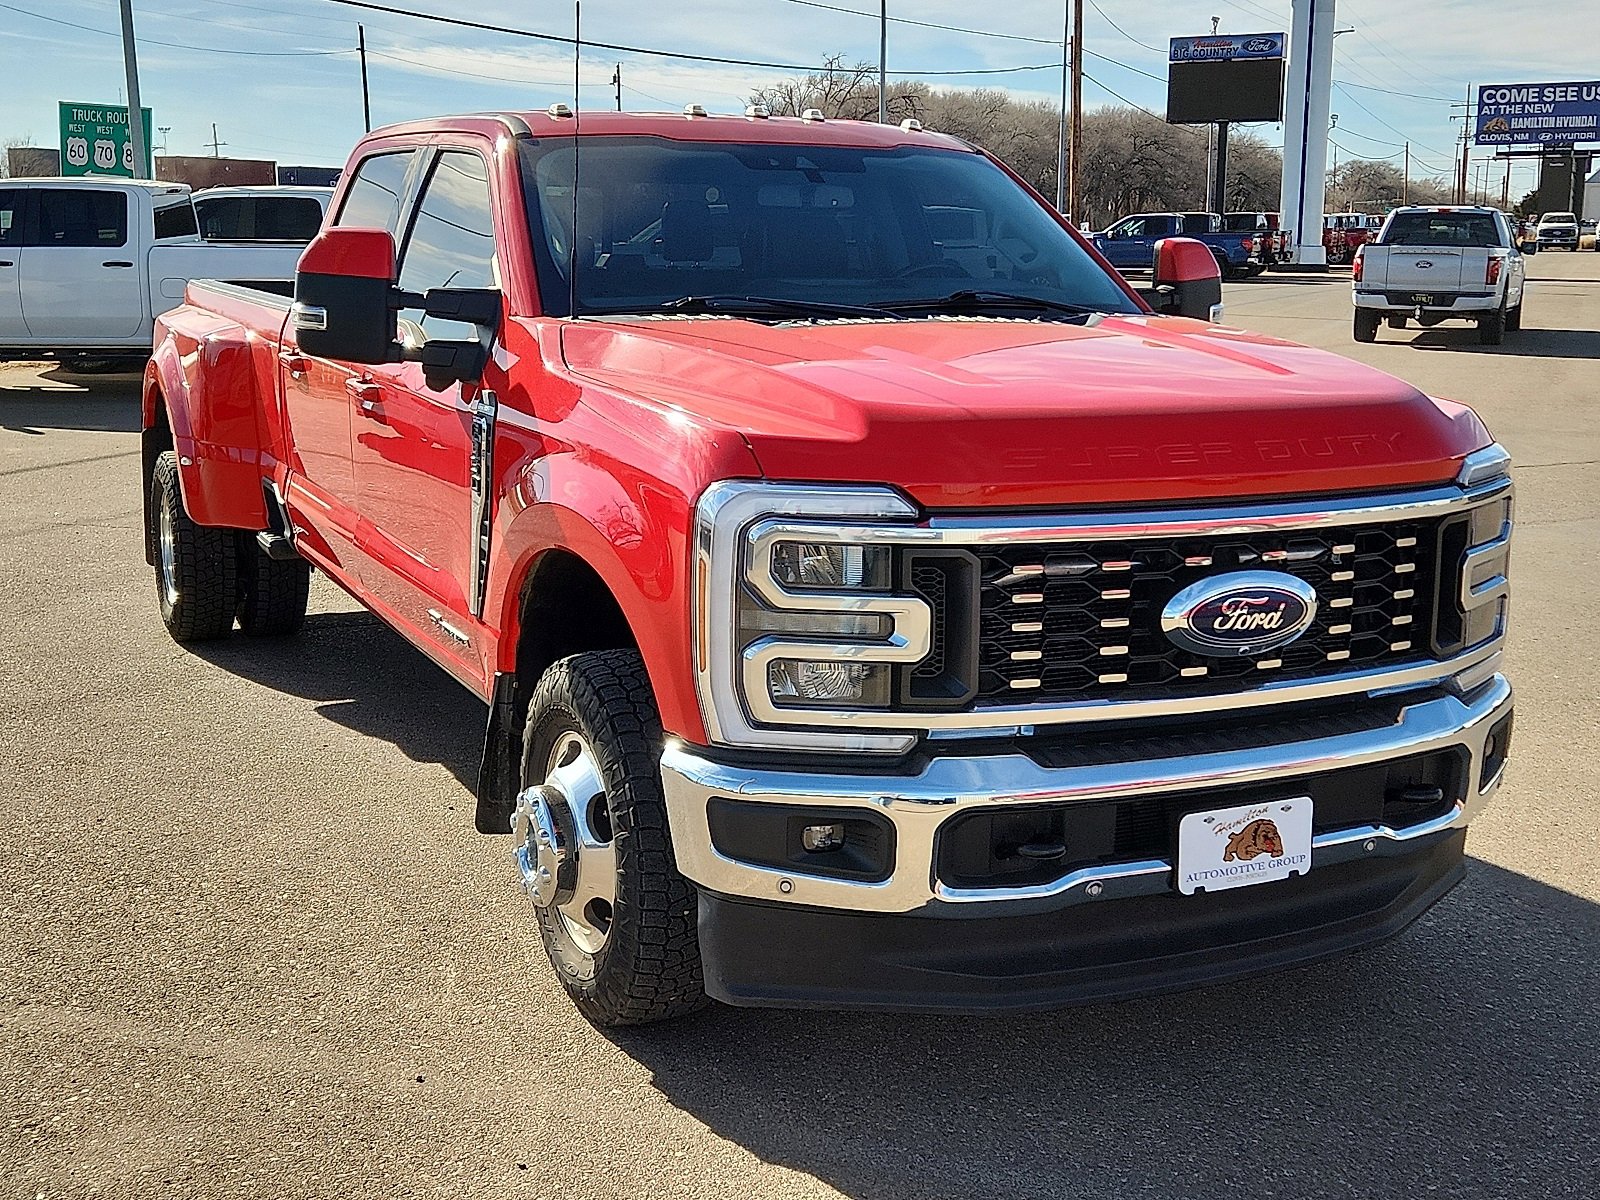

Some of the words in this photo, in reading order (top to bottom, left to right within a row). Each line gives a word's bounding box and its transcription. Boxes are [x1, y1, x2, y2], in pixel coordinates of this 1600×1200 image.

[1173, 47, 1189, 58] BIG
[1192, 46, 1239, 58] COUNTRY
[1247, 38, 1270, 51] Ford
[1482, 87, 1540, 104] COME
[1542, 86, 1579, 102] SEE
[72, 108, 103, 123] TRUCK
[1480, 105, 1497, 115] AT
[1499, 104, 1523, 114] THE
[1524, 103, 1555, 114] NEW
[68, 123, 86, 133] WEST
[1511, 116, 1556, 129] HAMILTON
[1556, 115, 1597, 128] HYUNDAI
[96, 125, 114, 135] WEST
[1479, 133, 1513, 142] CLOVIS,
[1513, 132, 1530, 141] NM
[1554, 132, 1596, 140] HYUNDAI
[69, 144, 85, 159] 60
[97, 145, 113, 161] 70
[125, 148, 133, 163] 8
[1003, 442, 1246, 467] SUPER
[1254, 432, 1401, 462] DUTY
[1213, 596, 1286, 630] Ford
[1212, 806, 1269, 837] Hamilton
[1186, 862, 1265, 882] AUTOMOTIVE
[1268, 854, 1307, 869] GROUP
